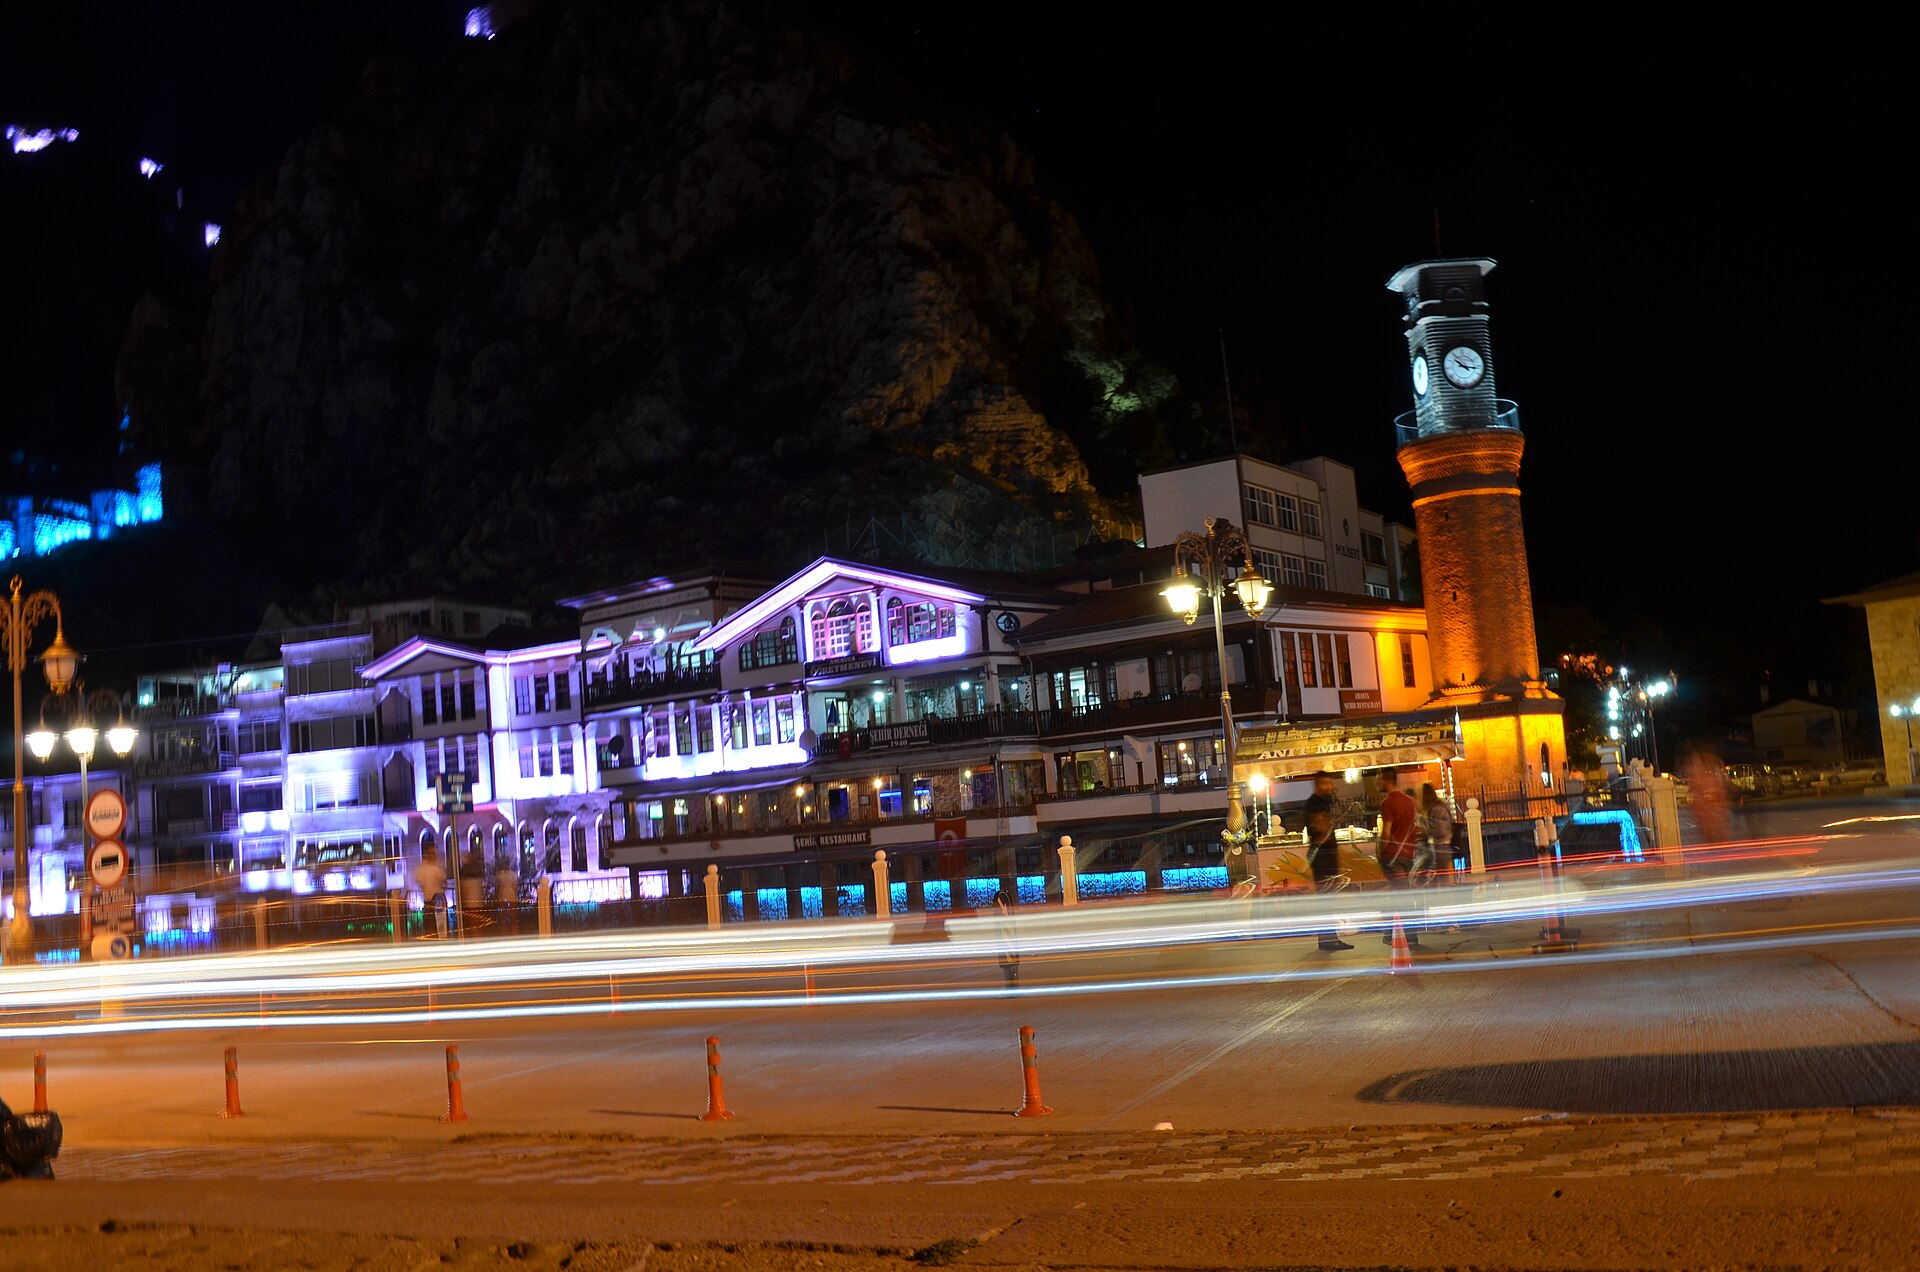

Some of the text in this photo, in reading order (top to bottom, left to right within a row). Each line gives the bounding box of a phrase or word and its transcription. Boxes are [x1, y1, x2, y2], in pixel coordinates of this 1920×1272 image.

[1356, 701, 1381, 709] RESTAURANT
[869, 720, 928, 746] ŞEHİR DERNEĞİ
[890, 739, 908, 748] 1940
[1257, 745, 1311, 760] ANIT
[795, 832, 867, 850] ŞEHİR RESTAURANT
